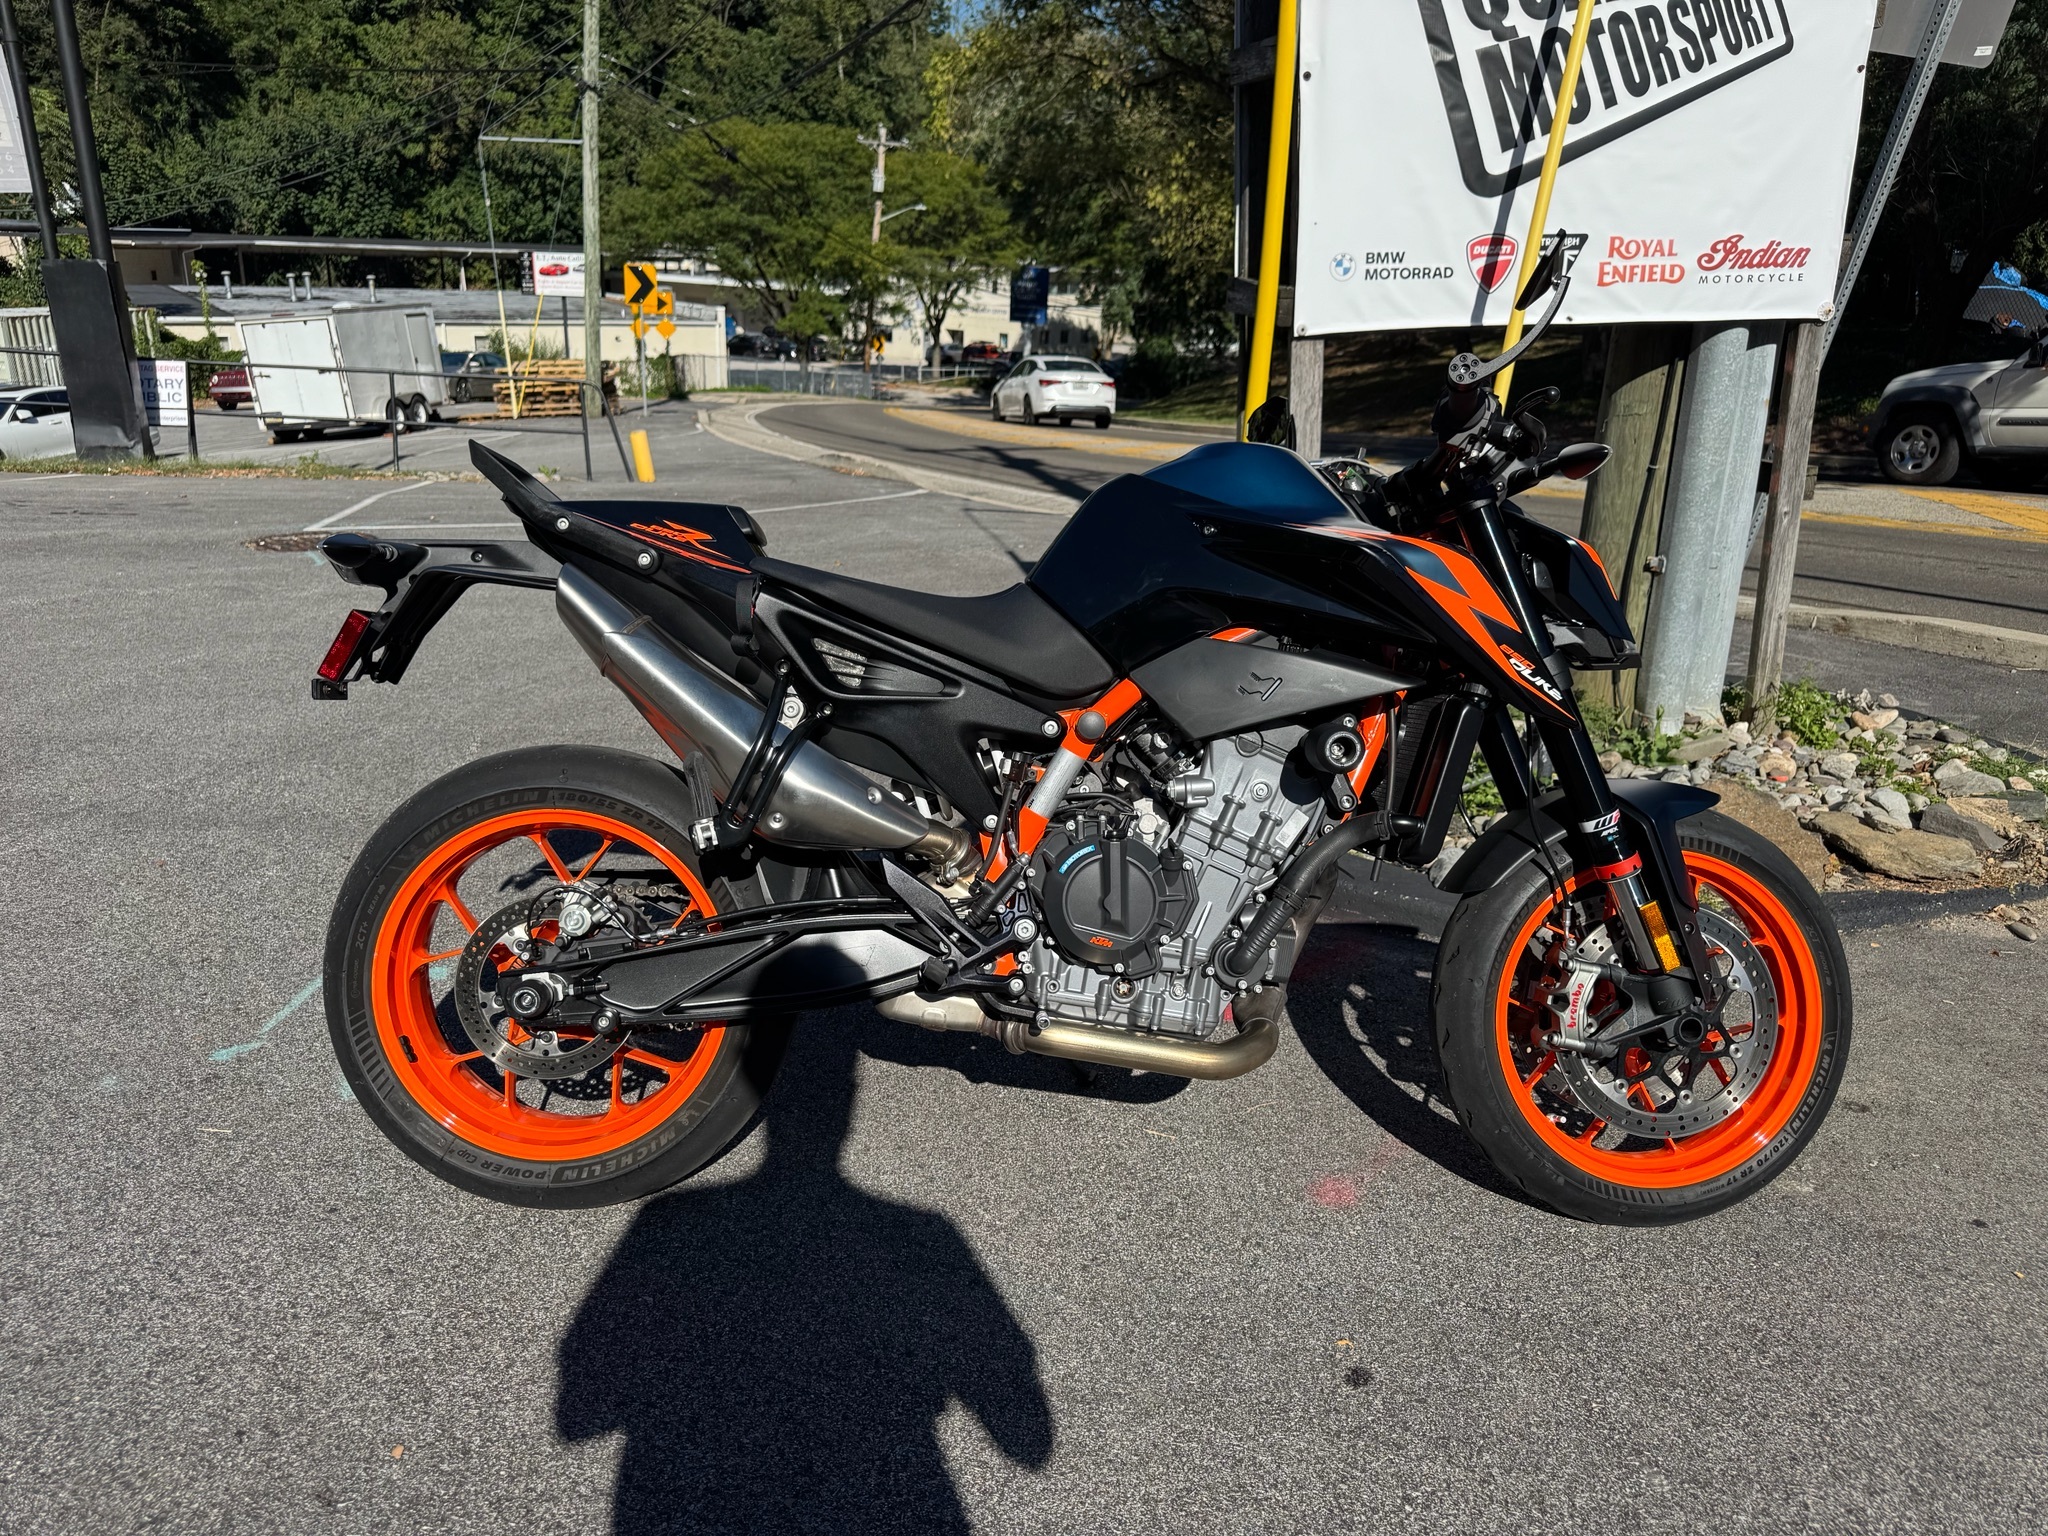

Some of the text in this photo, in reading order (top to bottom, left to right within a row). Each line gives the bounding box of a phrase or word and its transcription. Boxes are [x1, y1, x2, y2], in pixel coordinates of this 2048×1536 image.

[1475, 0, 1774, 154] MOTORSPORT
[1366, 251, 1405, 264] BMW
[1472, 244, 1512, 255] DUCATI
[1608, 236, 1678, 260] ROYAL
[1697, 234, 1811, 271] Indian
[1364, 267, 1454, 281] MOTORRAD
[1597, 261, 1686, 287] ENFIELD
[1698, 273, 1804, 284] MOTORCYCLE
[157, 365, 184, 373] SERVICE
[140, 378, 184, 389] TARY
[143, 392, 182, 403] BLIC
[1500, 644, 1536, 670] 890
[1509, 658, 1563, 701] DUKE
[423, 791, 540, 842] MICHELIN
[557, 792, 667, 831] 180/55 ZR 17
[367, 894, 379, 915] REAR
[355, 921, 369, 949] 2CT+
[1089, 936, 1114, 947] KTM
[1567, 983, 1585, 1029] brembo
[1791, 1055, 1831, 1132] MICHELIN
[561, 1127, 676, 1181] MICHELIN
[1756, 1136, 1790, 1167] 120/70
[480, 1160, 548, 1180] POWER
[1726, 1175, 1738, 1186] 17
[1740, 1165, 1754, 1178] ZR
